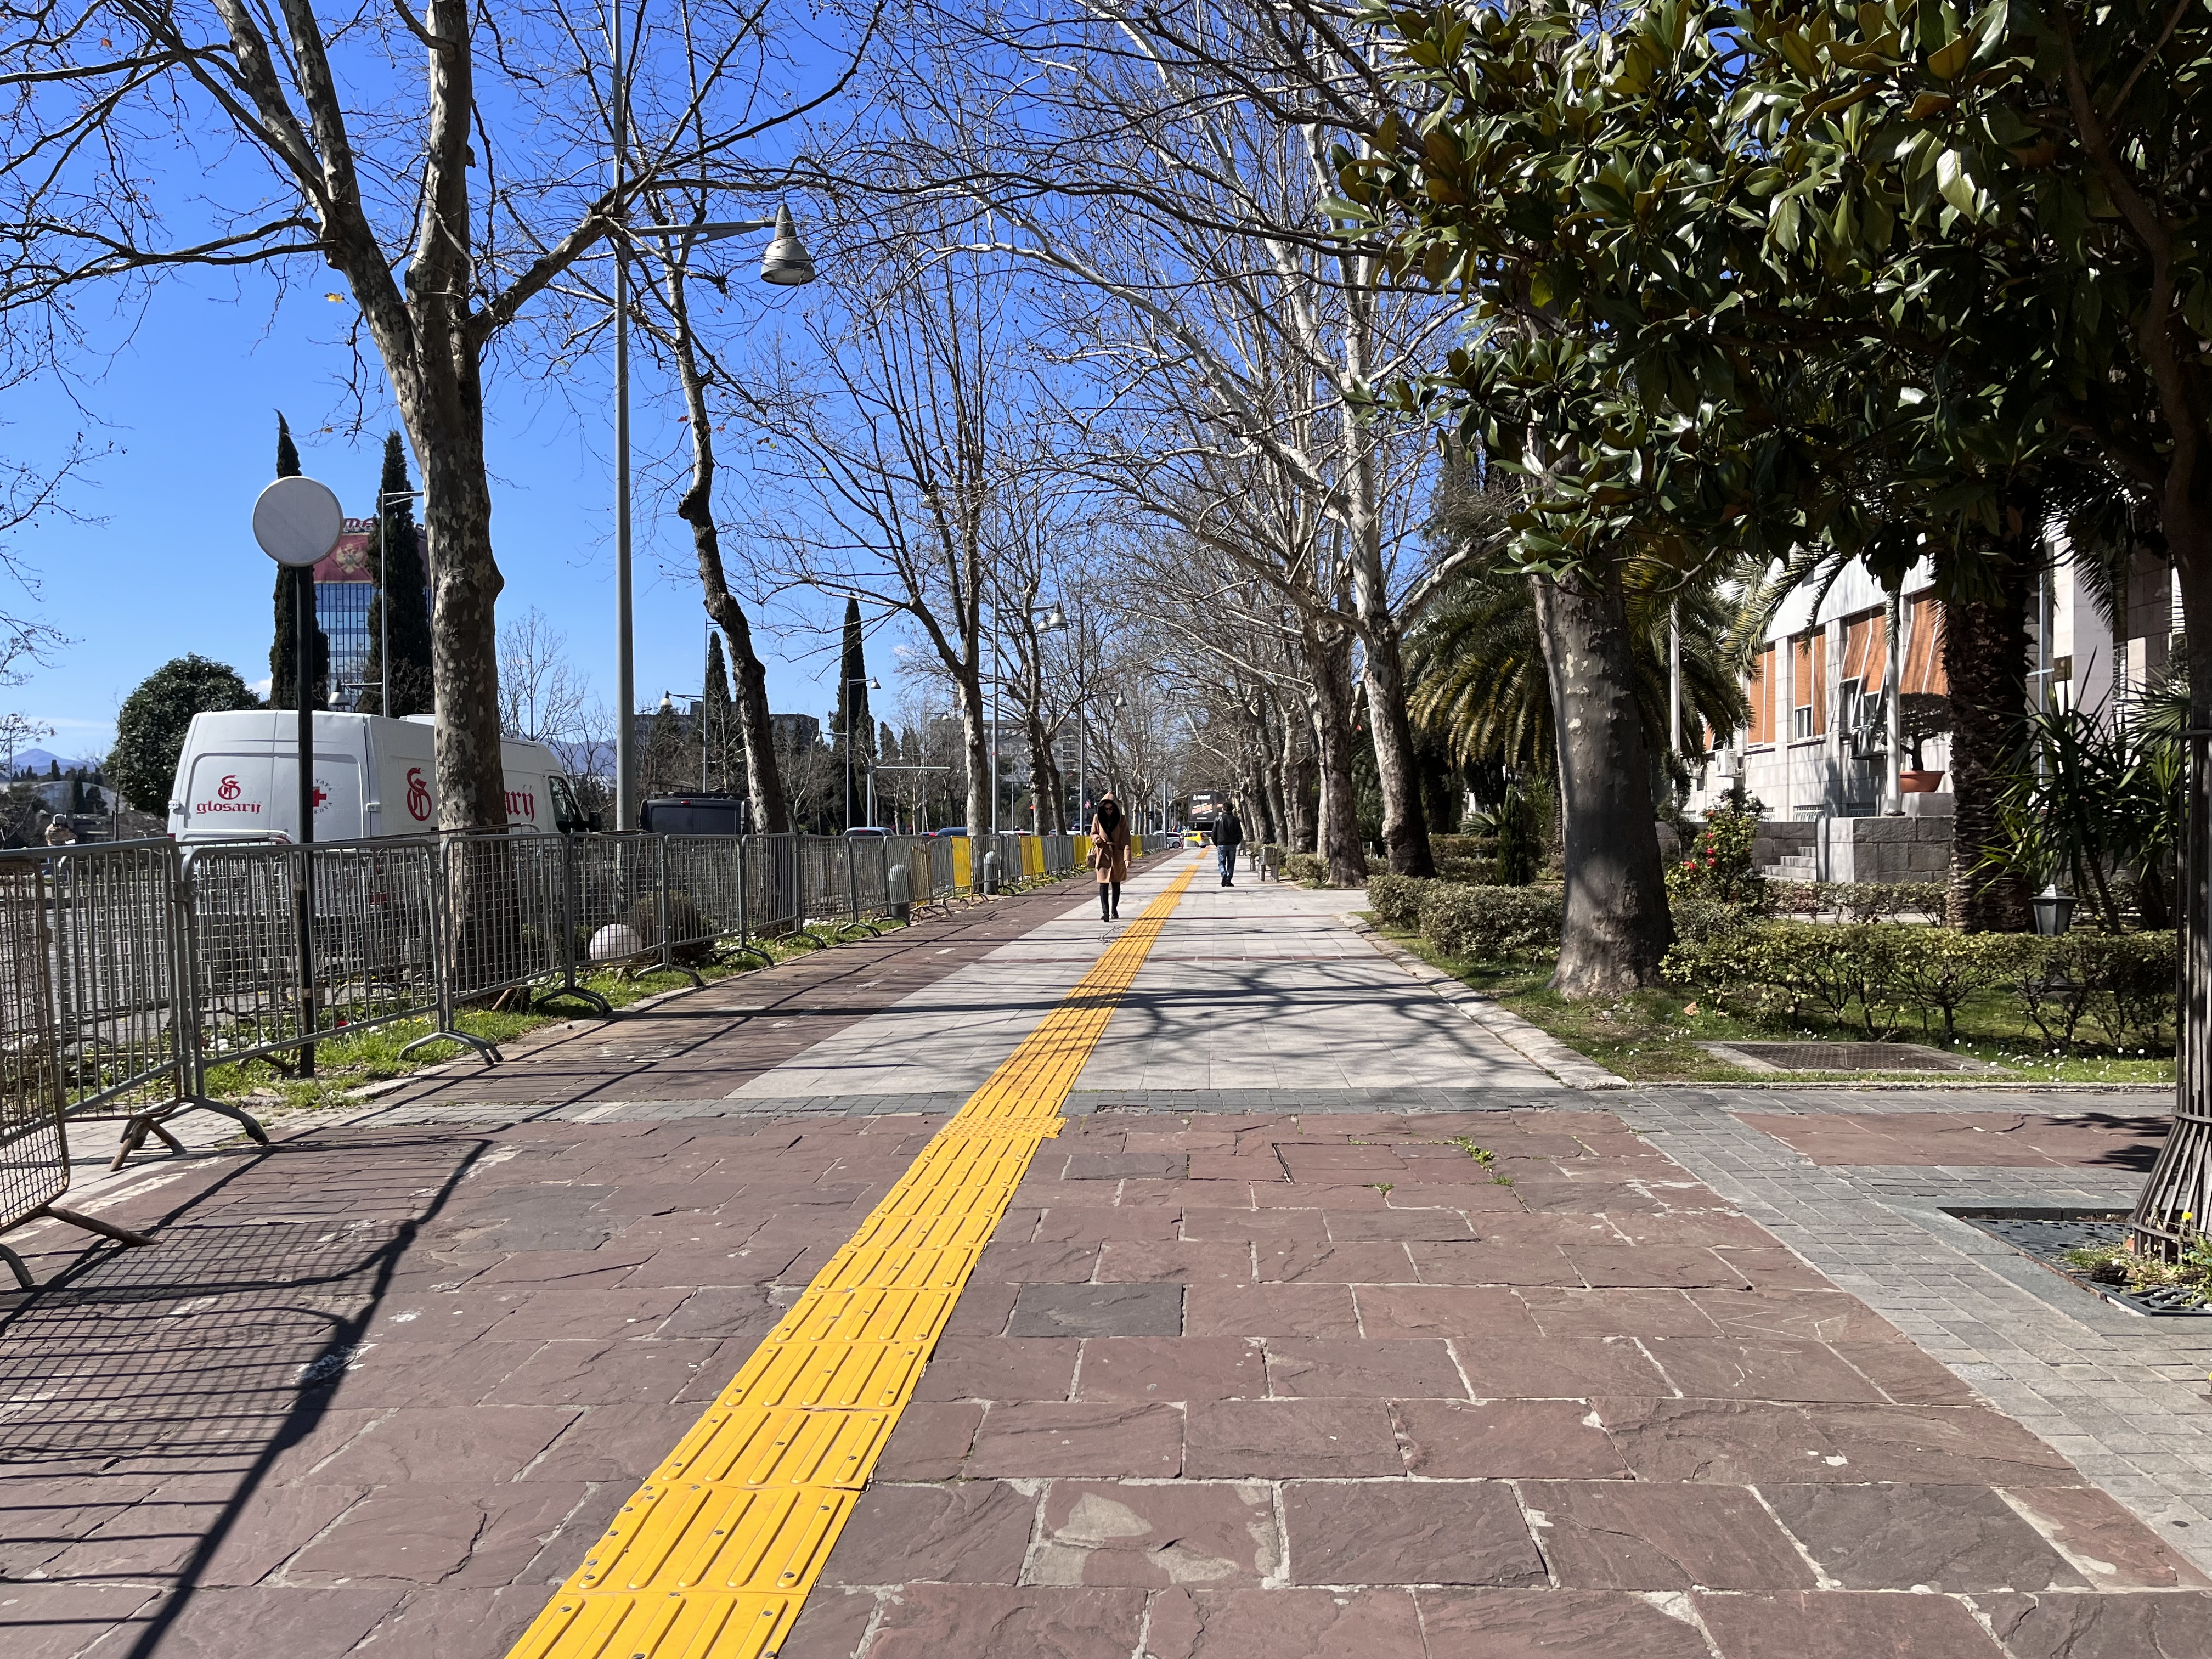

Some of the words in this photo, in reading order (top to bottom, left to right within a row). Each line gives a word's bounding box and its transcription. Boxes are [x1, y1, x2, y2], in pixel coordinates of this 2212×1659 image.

[315, 778, 332, 792] TAVA
[196, 800, 261, 814] glosarij
[314, 802, 332, 814] KOVA
